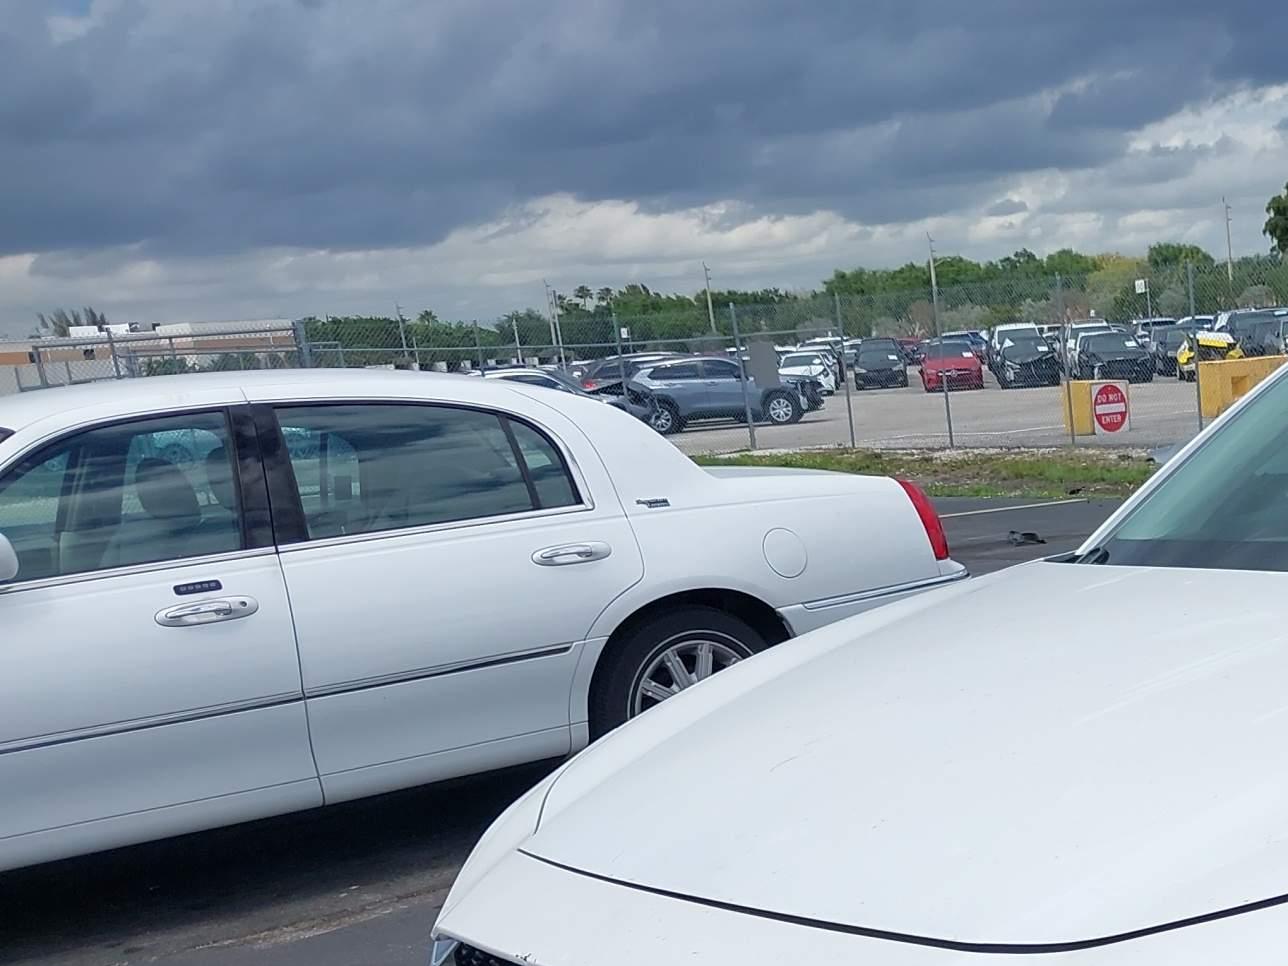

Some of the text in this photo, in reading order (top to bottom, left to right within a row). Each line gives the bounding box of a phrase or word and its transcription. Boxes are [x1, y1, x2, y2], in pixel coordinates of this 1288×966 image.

[1097, 393, 1122, 403] DO NOT
[1101, 415, 1122, 424] ENTER
